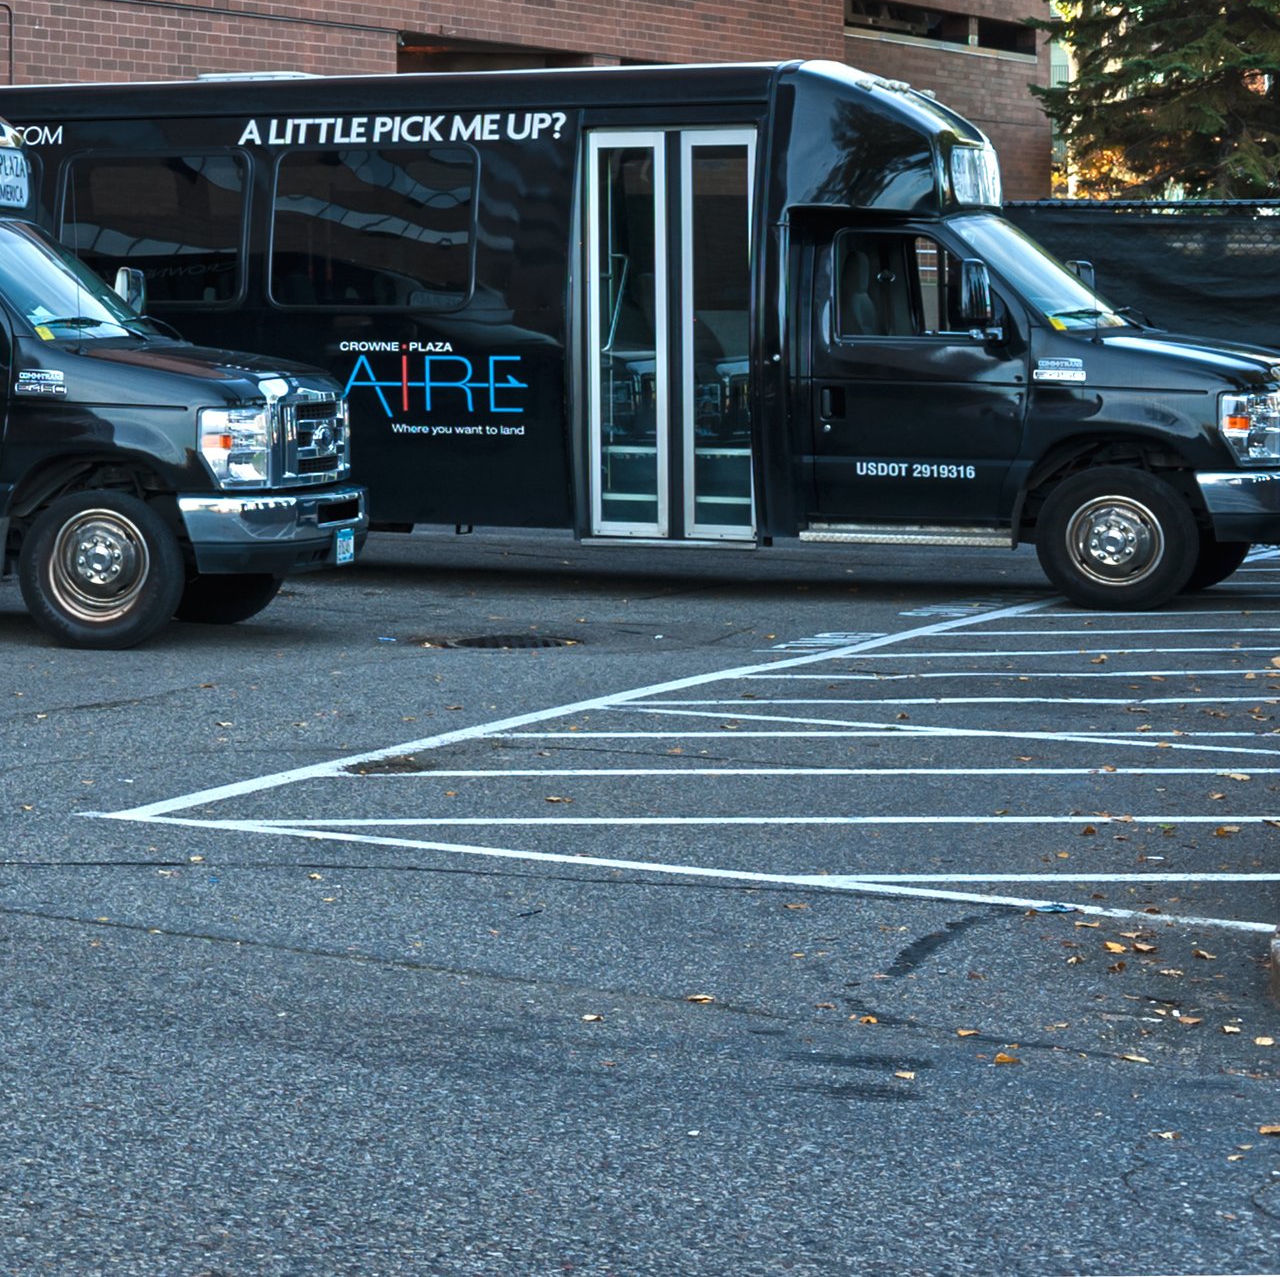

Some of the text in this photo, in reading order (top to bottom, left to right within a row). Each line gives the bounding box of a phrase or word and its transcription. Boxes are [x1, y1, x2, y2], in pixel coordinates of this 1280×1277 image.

[238, 112, 566, 145] A LITTLE PICK ME UP?
[340, 341, 453, 352] CROWNE PLAZA
[341, 354, 528, 418] AIRE
[391, 423, 525, 436] Where you want to land
[856, 461, 976, 479] USDOT 2919316
